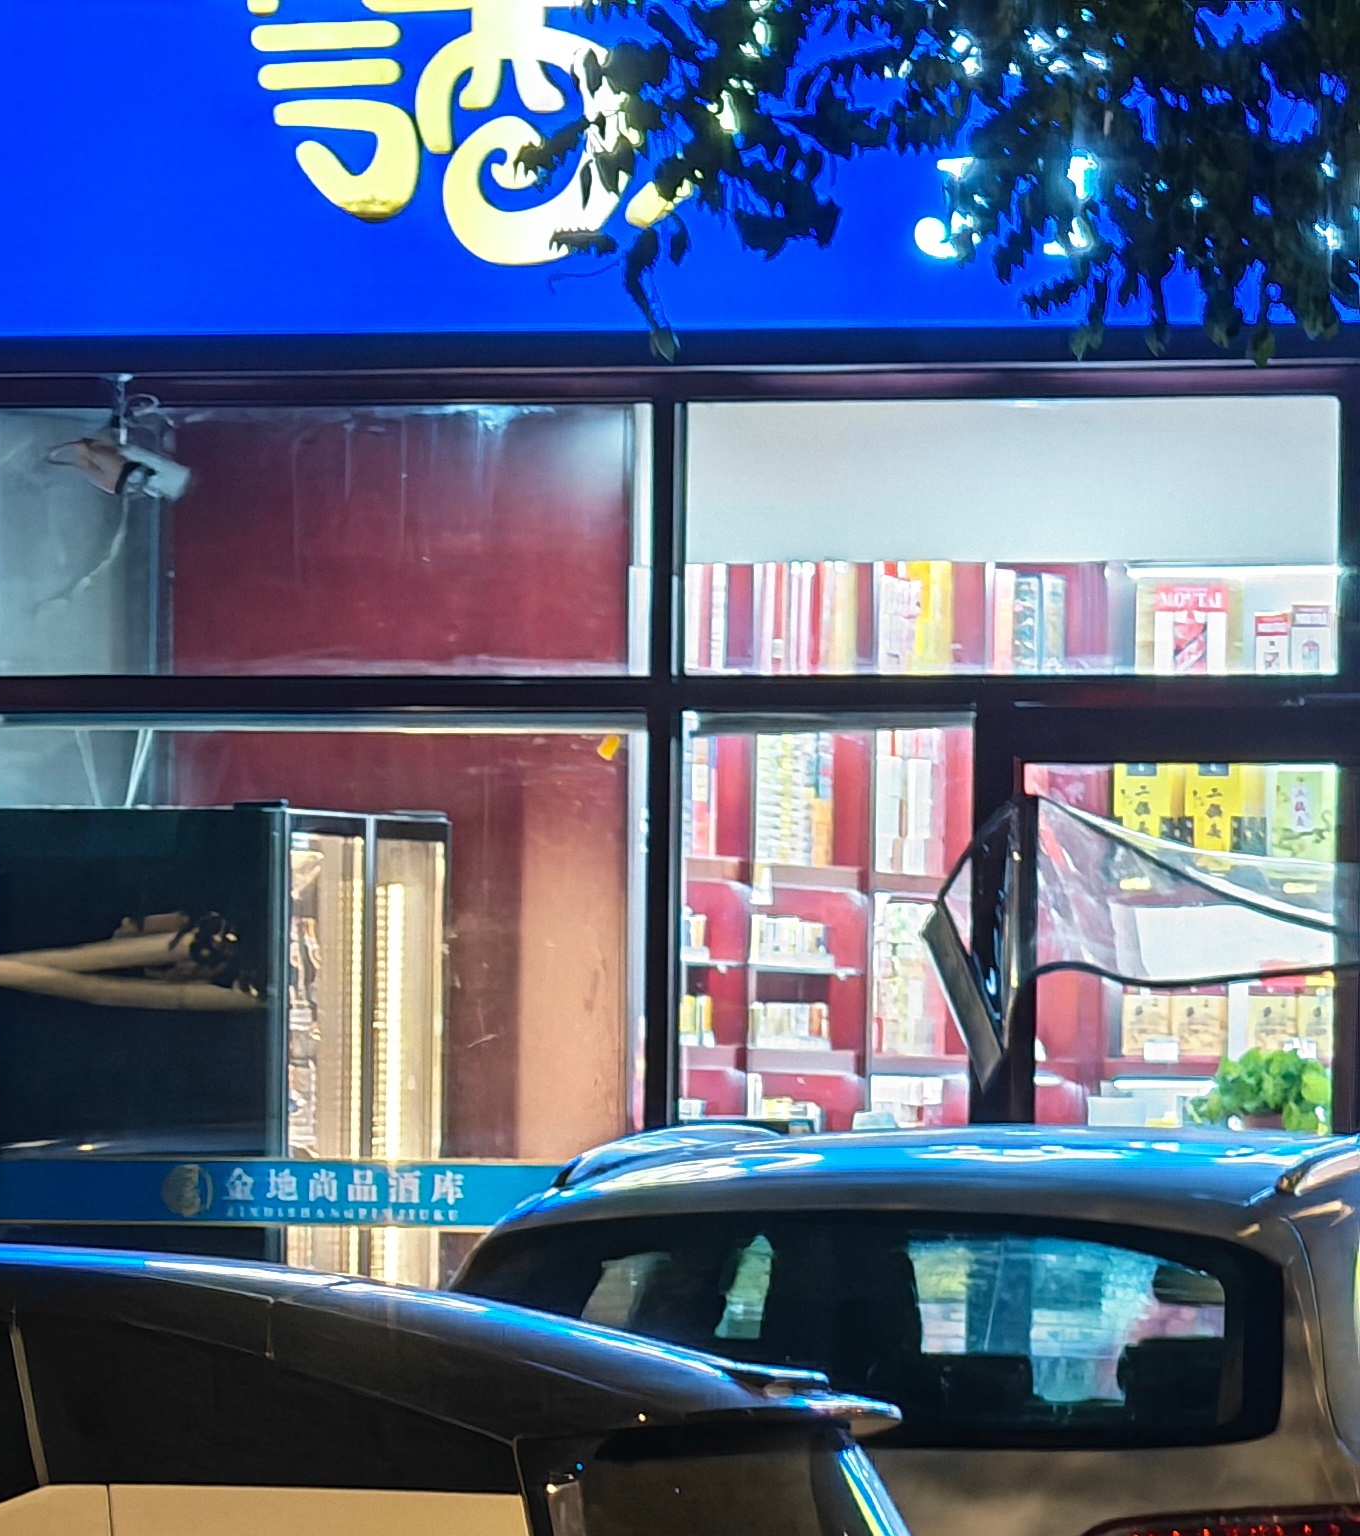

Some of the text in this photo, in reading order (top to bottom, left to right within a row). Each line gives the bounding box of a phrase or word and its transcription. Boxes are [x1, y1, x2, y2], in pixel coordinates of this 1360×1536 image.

[222, 1167, 465, 1205] 金地尚品酒库
